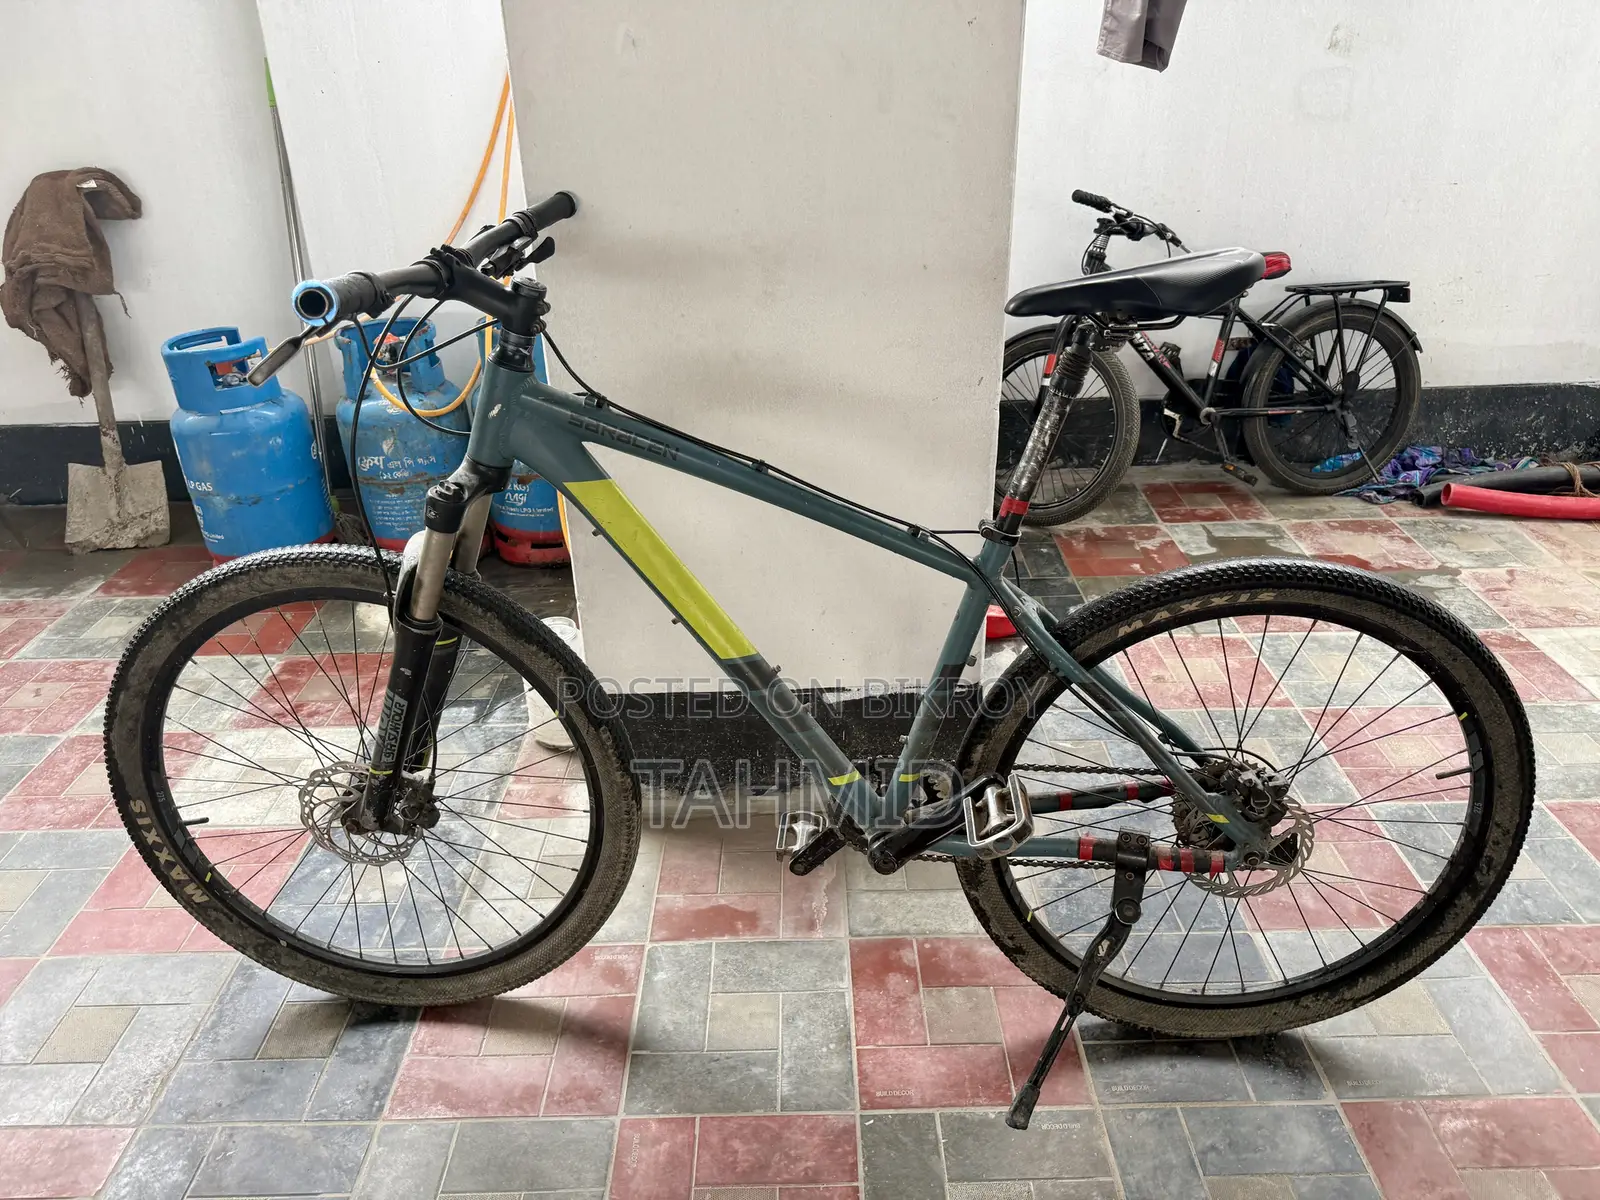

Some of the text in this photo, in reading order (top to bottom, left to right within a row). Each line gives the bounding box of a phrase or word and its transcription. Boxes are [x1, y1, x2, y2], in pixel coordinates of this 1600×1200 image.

[196, 481, 213, 491] GAS
[1117, 592, 1277, 638] MAXXIS
[130, 799, 210, 903] MAXXIS
